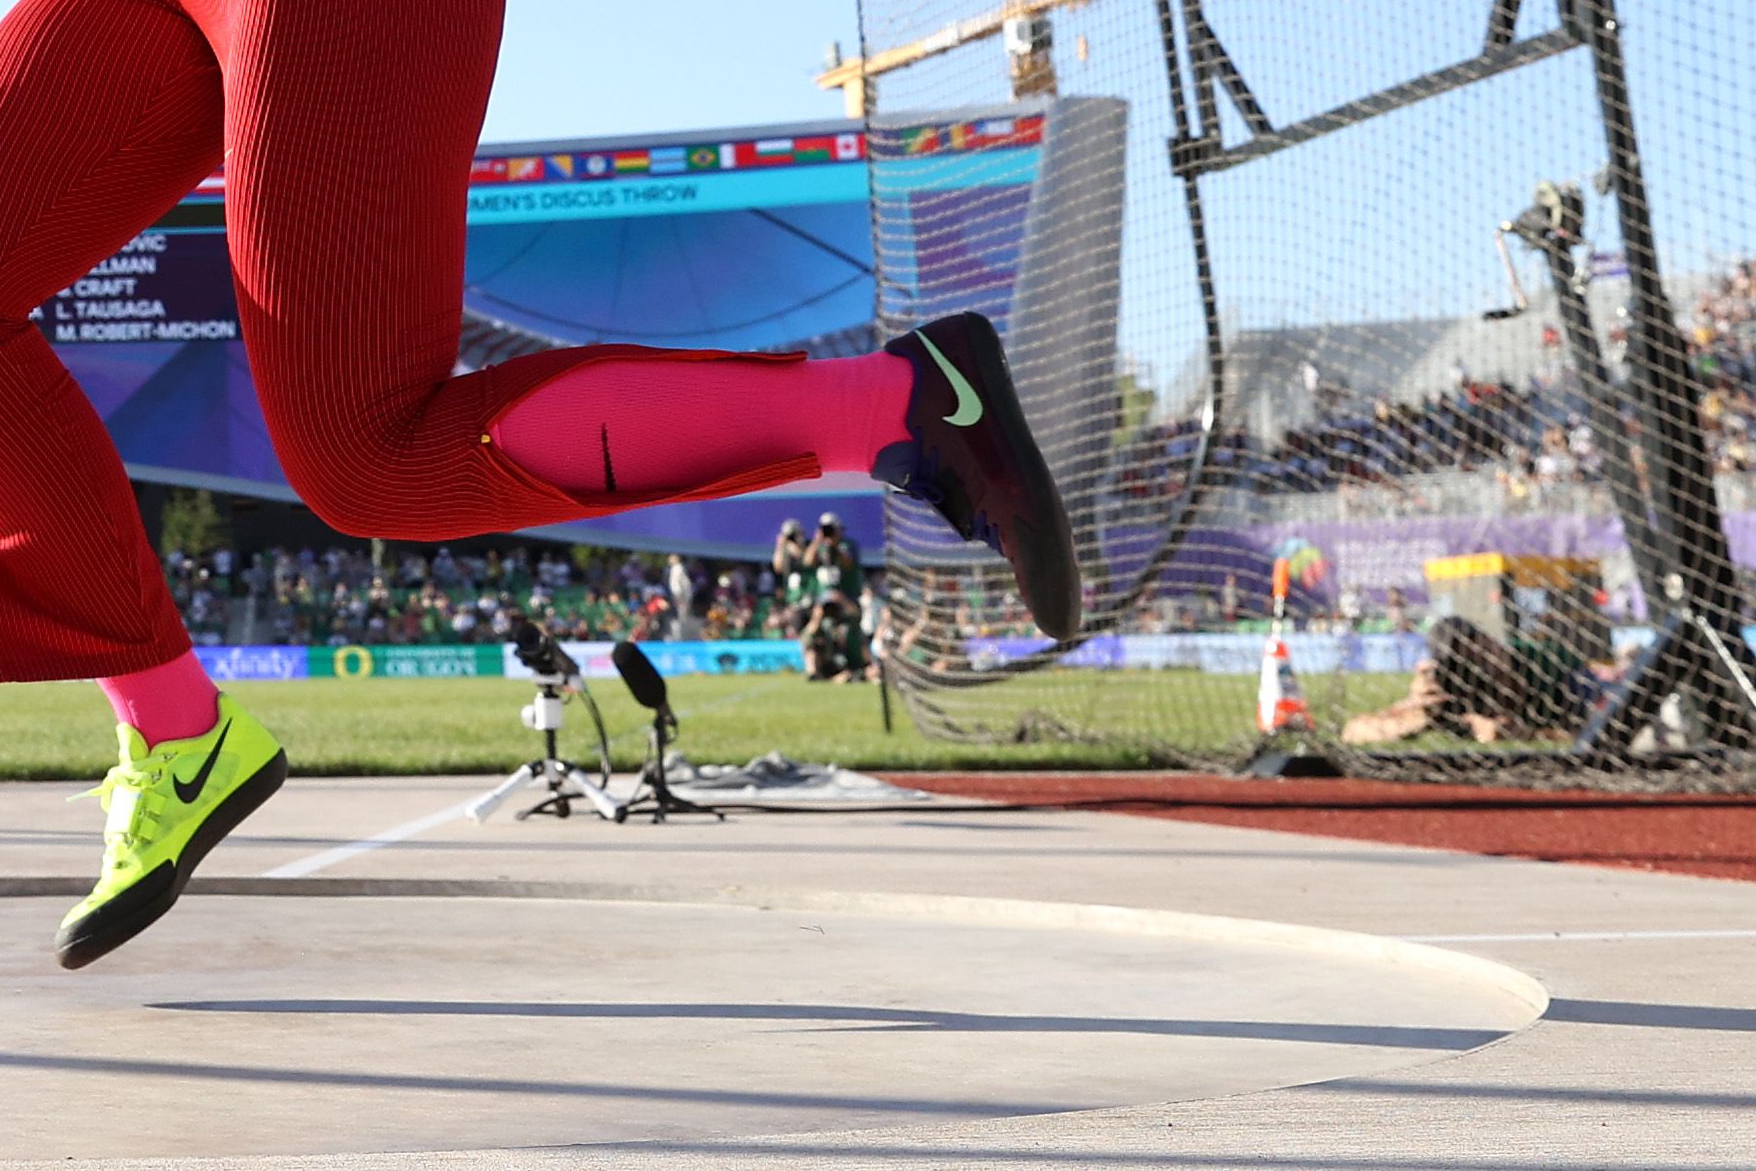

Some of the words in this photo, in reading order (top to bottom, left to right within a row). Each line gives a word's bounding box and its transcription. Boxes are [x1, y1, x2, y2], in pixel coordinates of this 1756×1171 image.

[469, 194, 536, 212] MEN'S
[541, 188, 615, 209] DISCUS
[623, 182, 698, 202] THROW
[74, 278, 137, 296] CRAFT
[75, 300, 166, 318] TAUSAGA
[79, 321, 236, 340] ROBERT-MICHON
[214, 647, 298, 680] xfinity
